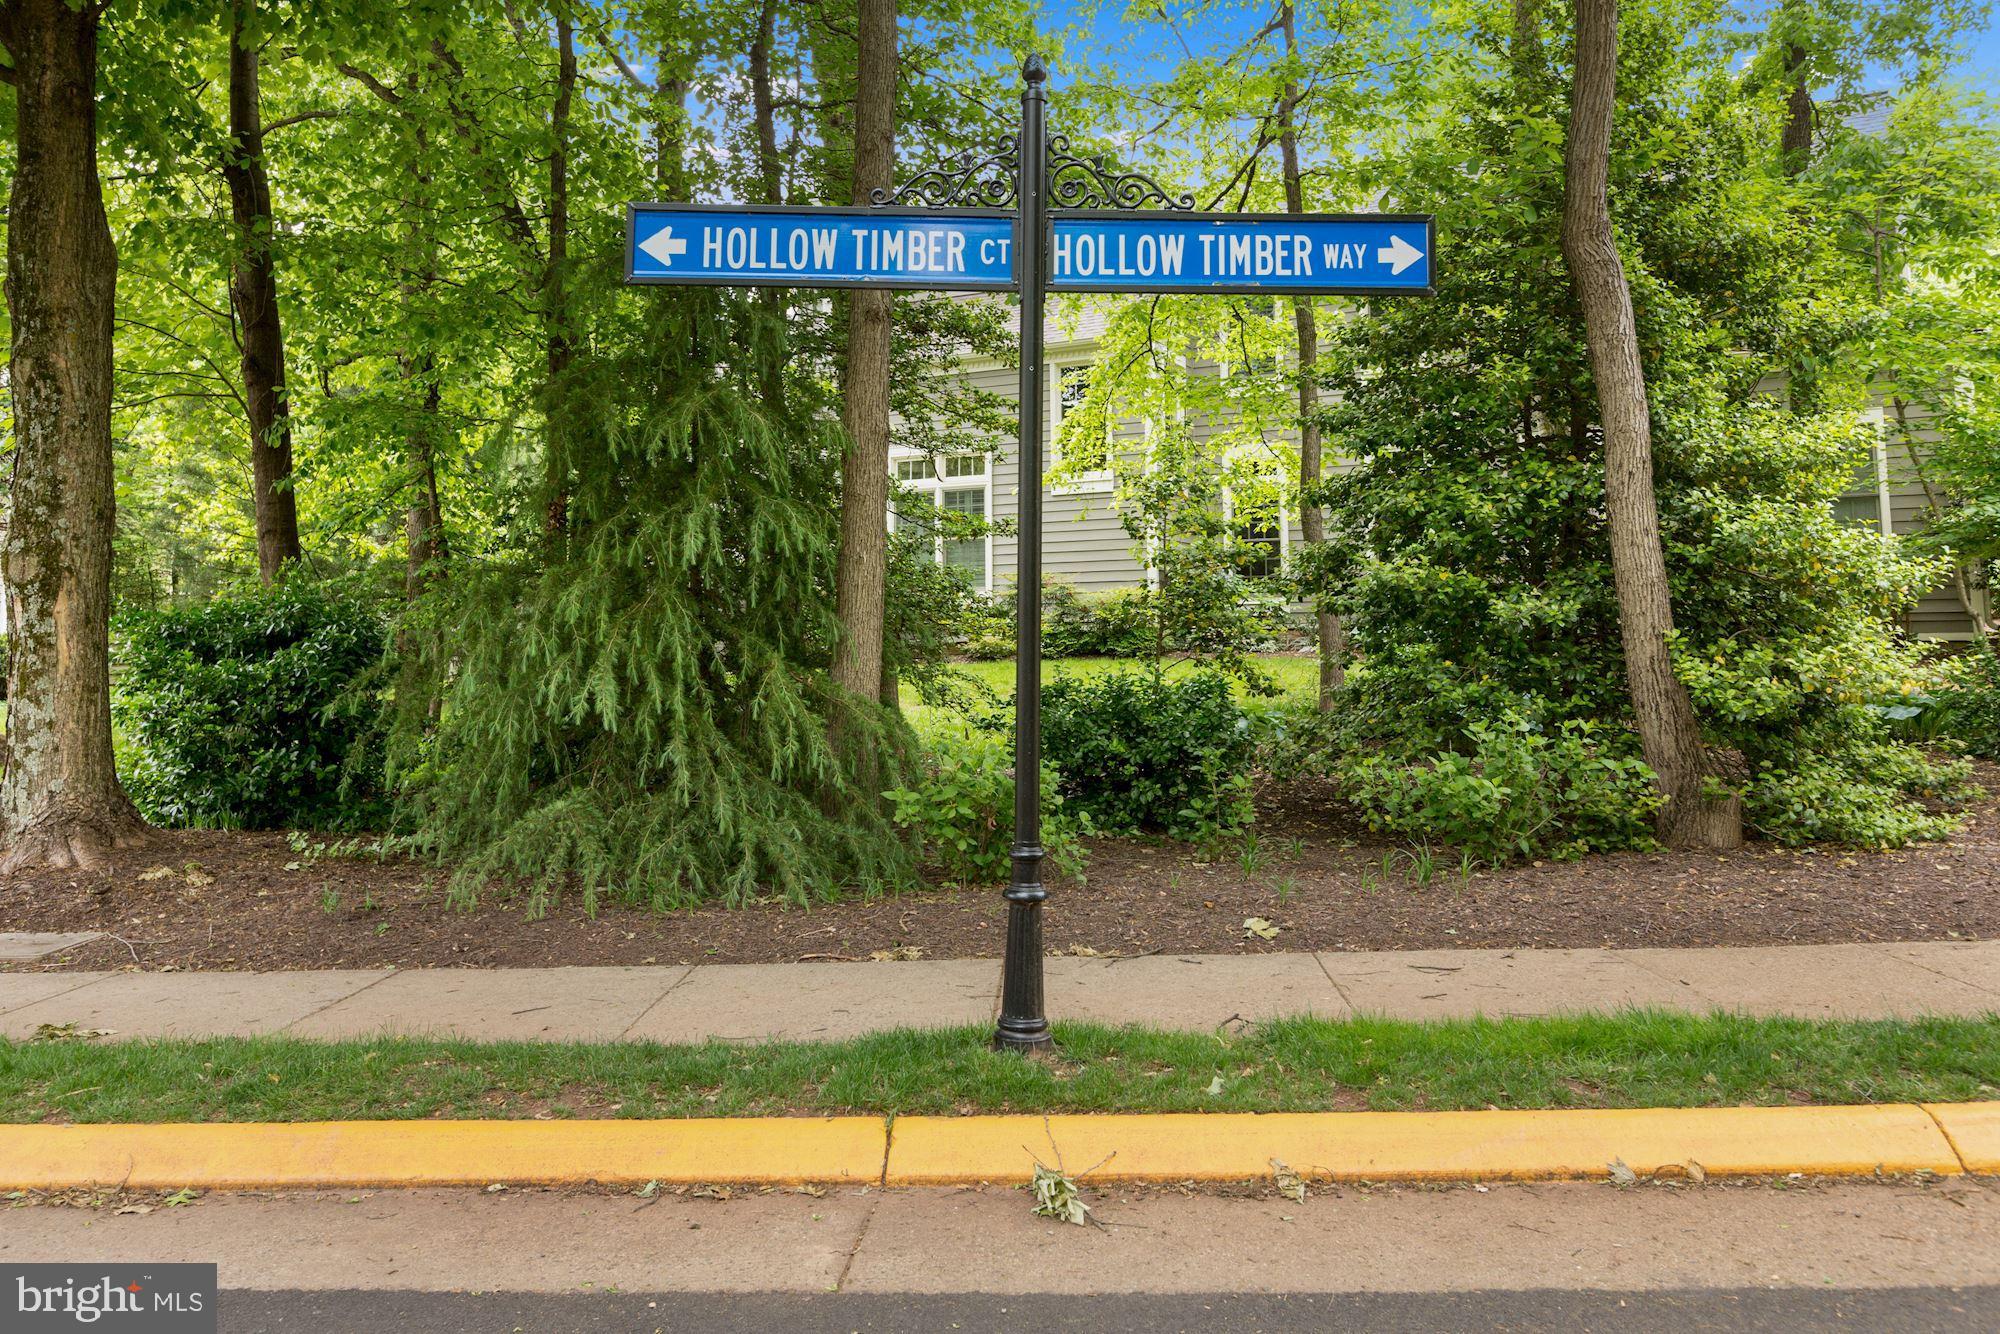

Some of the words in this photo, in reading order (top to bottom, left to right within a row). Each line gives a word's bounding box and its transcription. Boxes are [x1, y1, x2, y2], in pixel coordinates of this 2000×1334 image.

[703, 226, 838, 270] HOLLOW
[852, 229, 966, 273] TIMBER
[980, 238, 1011, 265] CT
[1053, 234, 1185, 276] HOLLOW
[1198, 234, 1313, 276] TIMBER
[1323, 243, 1367, 269] WAY
